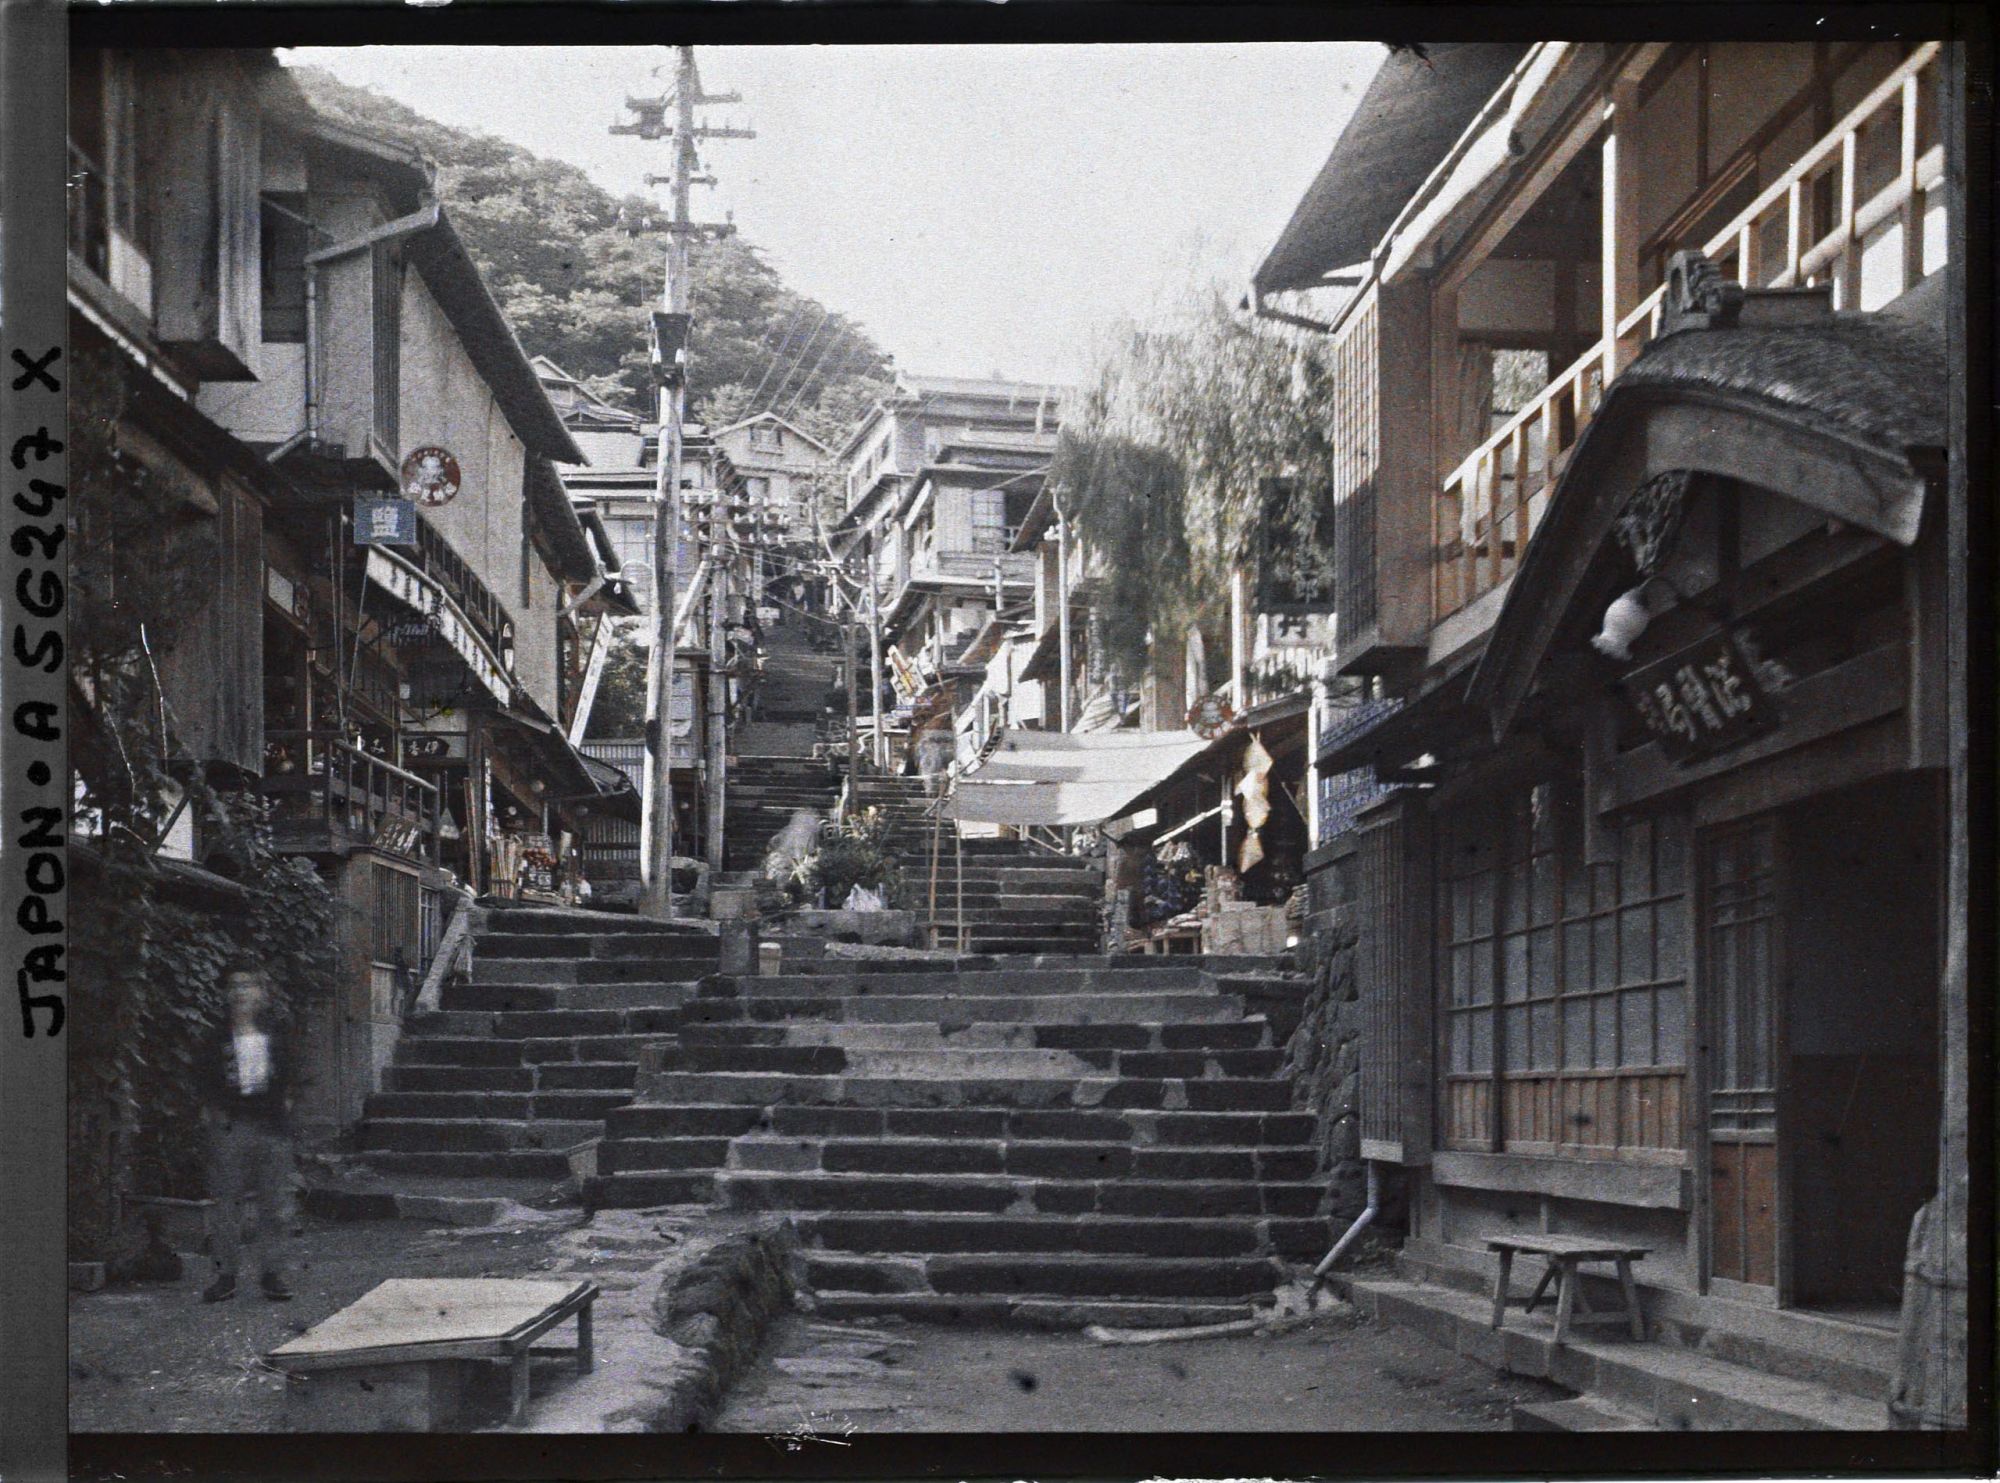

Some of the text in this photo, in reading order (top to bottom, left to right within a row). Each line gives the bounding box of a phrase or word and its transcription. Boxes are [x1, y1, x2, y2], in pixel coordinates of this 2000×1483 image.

[11, 346, 62, 393] X
[12, 700, 61, 742] A
[16, 805, 66, 1039] JAPON
